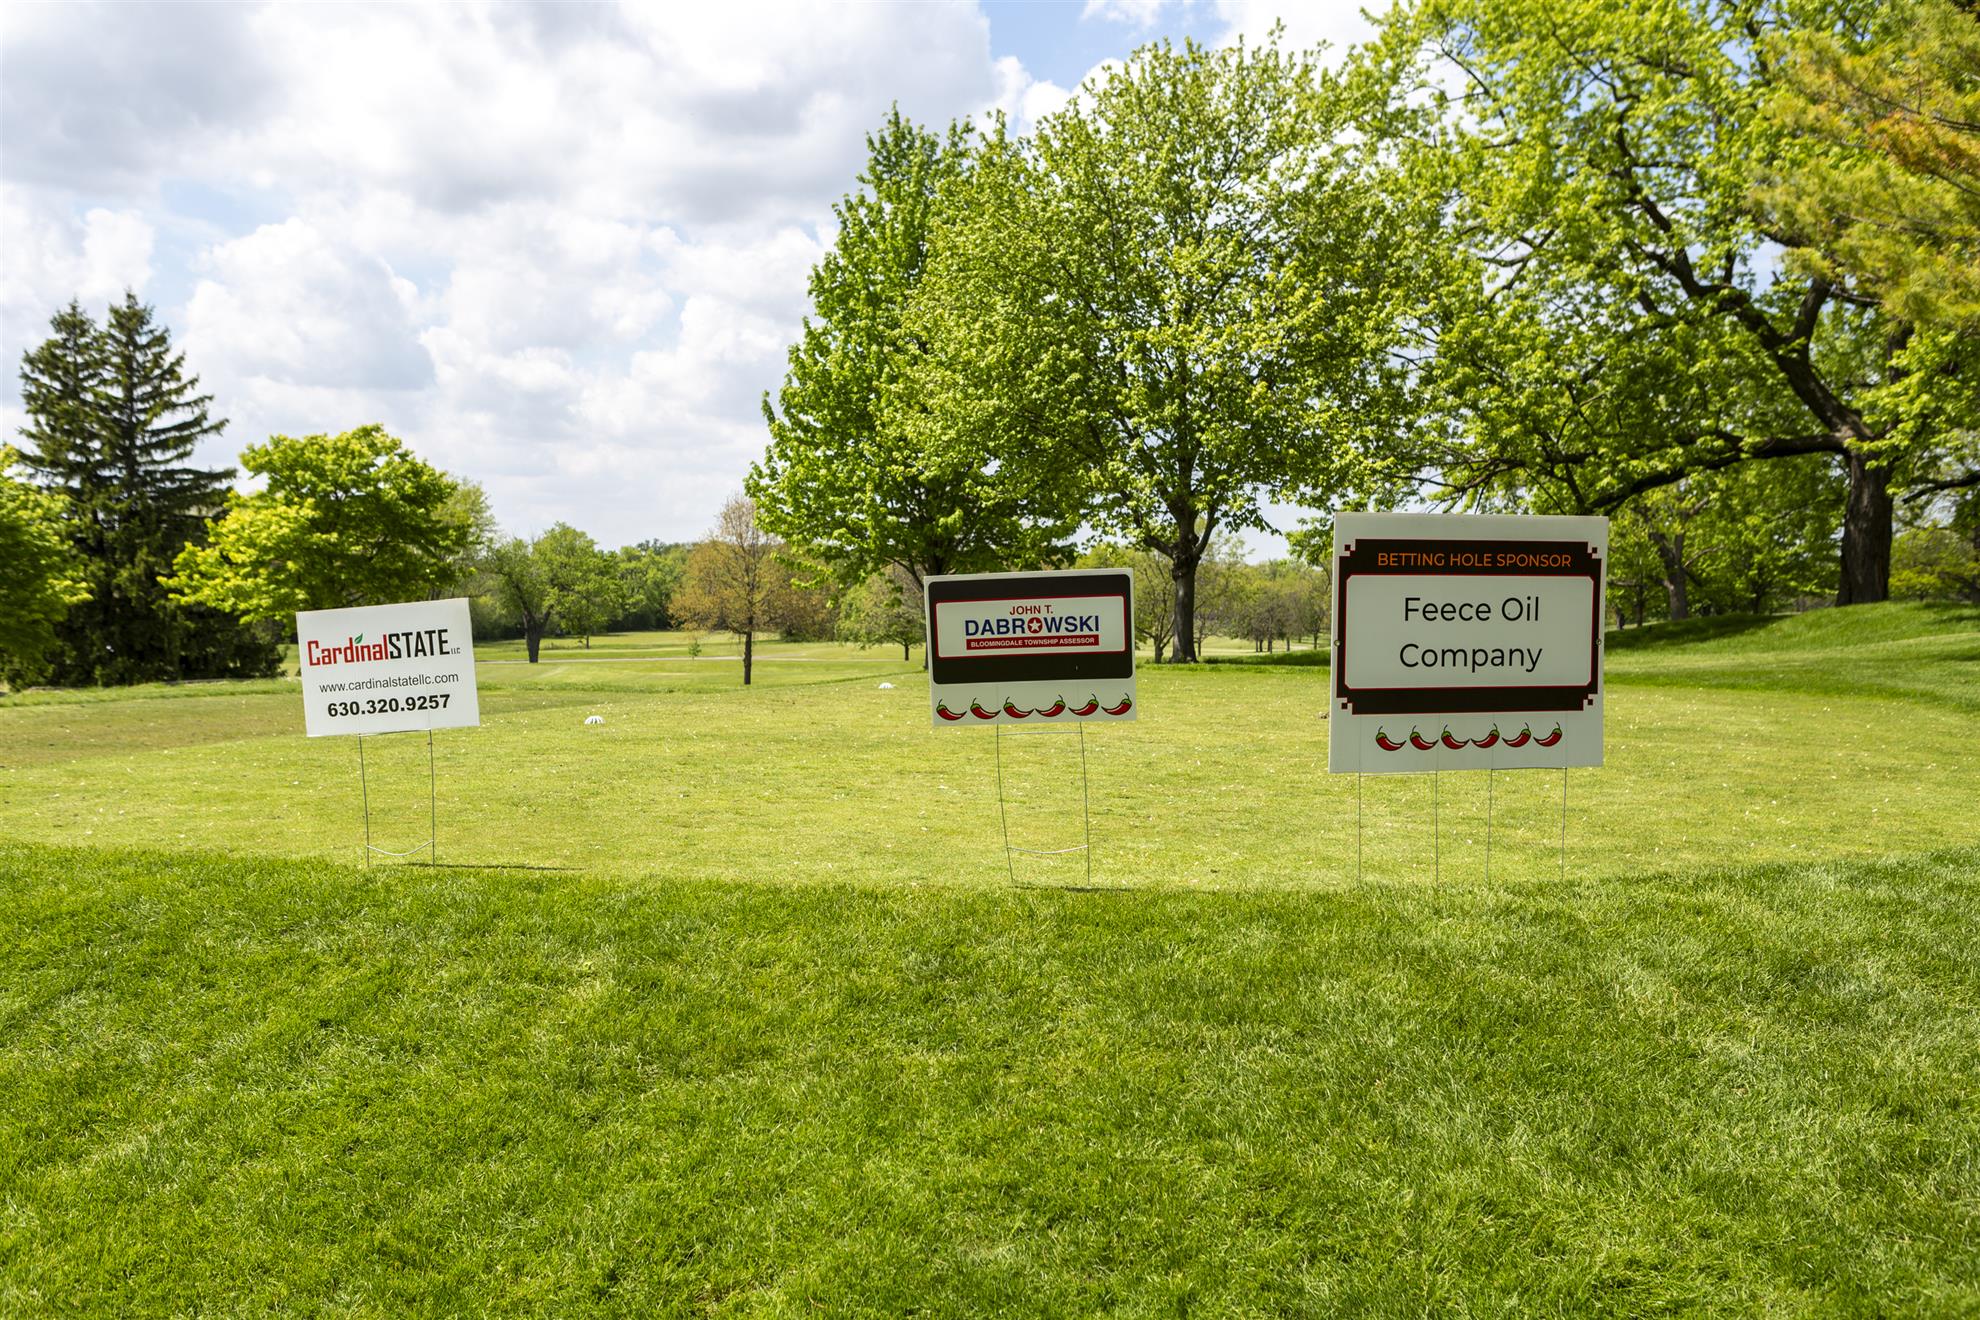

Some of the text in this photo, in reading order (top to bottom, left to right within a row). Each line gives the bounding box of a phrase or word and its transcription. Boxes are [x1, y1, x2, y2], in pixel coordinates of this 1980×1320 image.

[1377, 553, 1572, 568] BETTING HOLE SPONSOR
[1009, 604, 1054, 616] JOHN T.
[1404, 596, 1540, 622] Feece Oil
[964, 615, 1100, 637] DABROWSKI
[970, 636, 1095, 648] BLOOMINGDALE TOWNSHIP ASSESSOR
[1399, 643, 1543, 674] Company
[319, 672, 459, 694] www.cardinalstatellc.com
[327, 693, 451, 718] 630.320.9257
